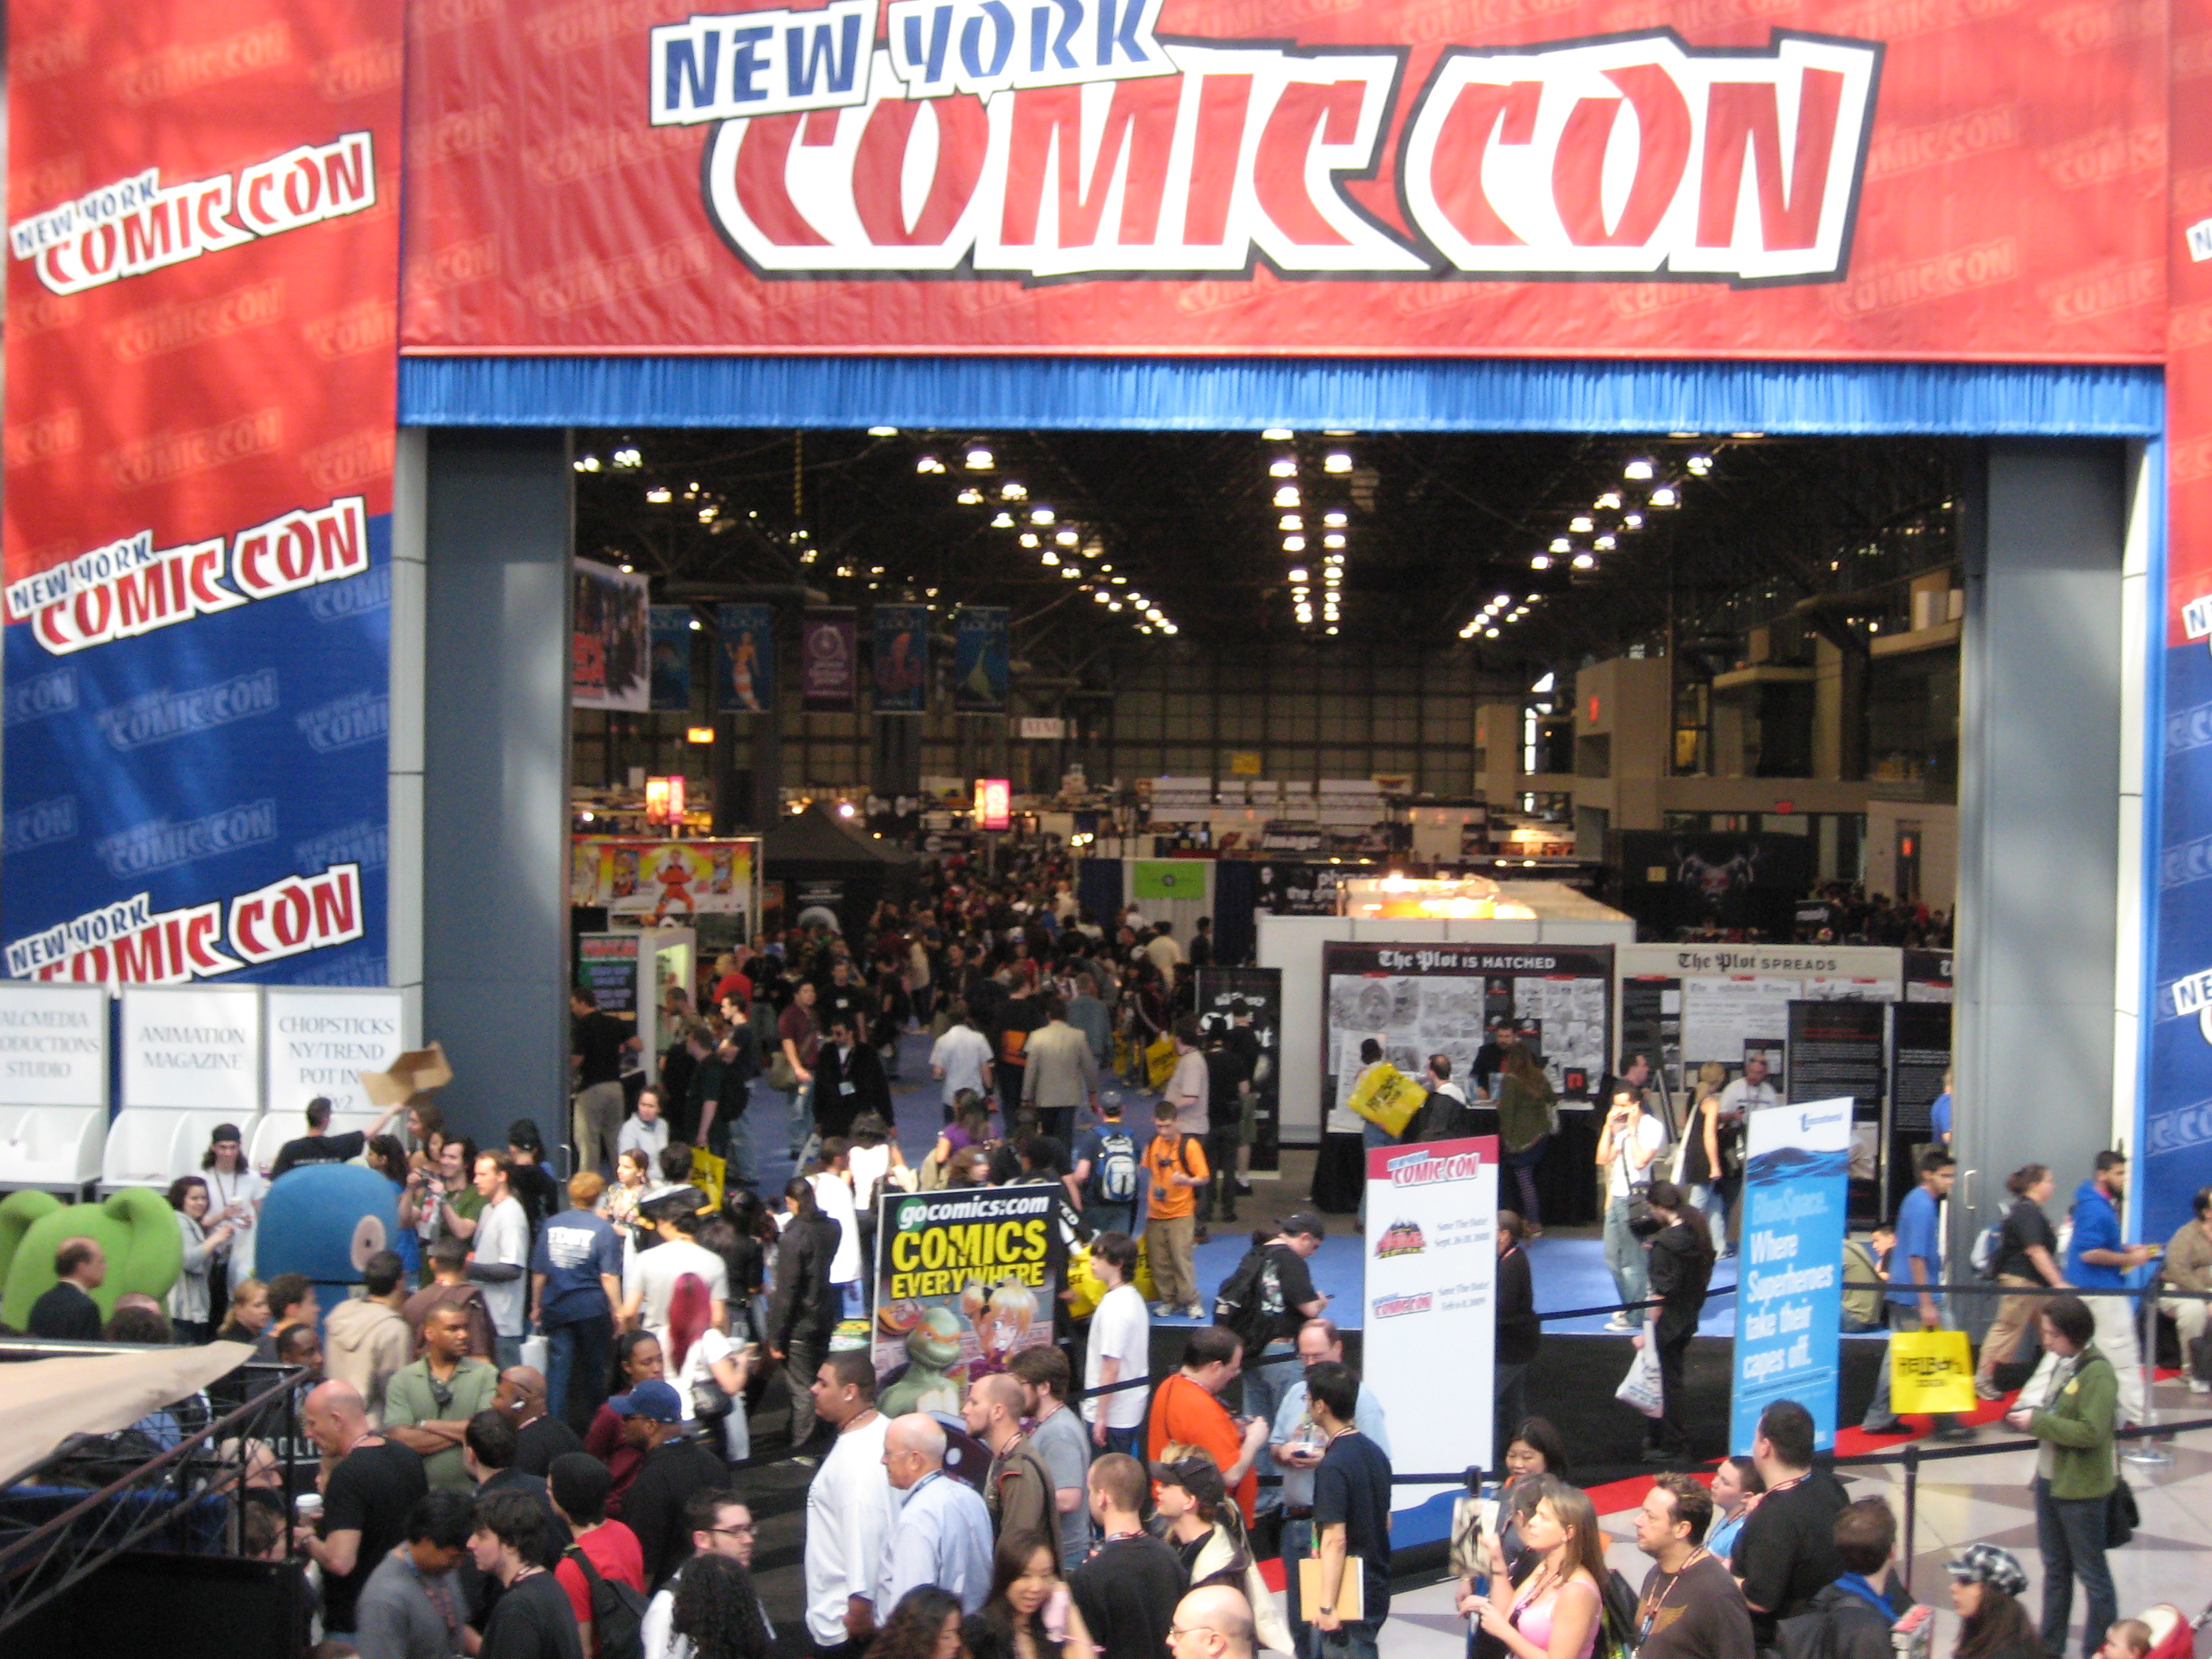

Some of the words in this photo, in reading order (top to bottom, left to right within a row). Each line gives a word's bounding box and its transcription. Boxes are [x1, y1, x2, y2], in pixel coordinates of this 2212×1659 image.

[666, 14, 862, 109] NEW
[904, 0, 1151, 84] YORK
[734, 73, 1367, 249] COMIC
[1430, 63, 1845, 252] CON
[17, 212, 73, 253] NEW
[80, 176, 157, 222] YORK
[46, 188, 226, 284] COMIC
[248, 143, 367, 225] CON
[11, 571, 68, 611] NEW
[76, 539, 152, 583] YORK
[40, 549, 222, 645] COMIC
[241, 507, 359, 589] CON
[235, 873, 355, 955] CON
[11, 933, 65, 970] NEW
[73, 902, 149, 946] YORK
[1379, 950, 1413, 970] The
[1417, 950, 1458, 972] Plot
[1462, 956, 1478, 968] IS
[1482, 956, 1556, 970] HATCHED
[1677, 953, 1711, 972] The
[1714, 953, 1756, 973] Plot
[1761, 958, 1838, 971] SPREADS
[139, 1027, 245, 1045] ANIMATION
[279, 1016, 395, 1035] CHOPSTICKS
[143, 1051, 243, 1070] MAGAZINE
[289, 1042, 385, 1060] NY/TREND
[1395, 1159, 1445, 1185] COMIC
[1447, 1154, 1477, 1178] CON
[898, 1195, 1049, 1231] gocomics.com
[891, 1219, 1048, 1272] COMICS
[1750, 1229, 1799, 1264] Where
[891, 1262, 1046, 1299] EVERYWHERE
[1747, 1264, 1835, 1307] Superheroes
[1745, 1305, 1777, 1341] take
[1780, 1298, 1813, 1333] their
[1743, 1349, 1786, 1383] capes
[1788, 1334, 1812, 1369] off.
